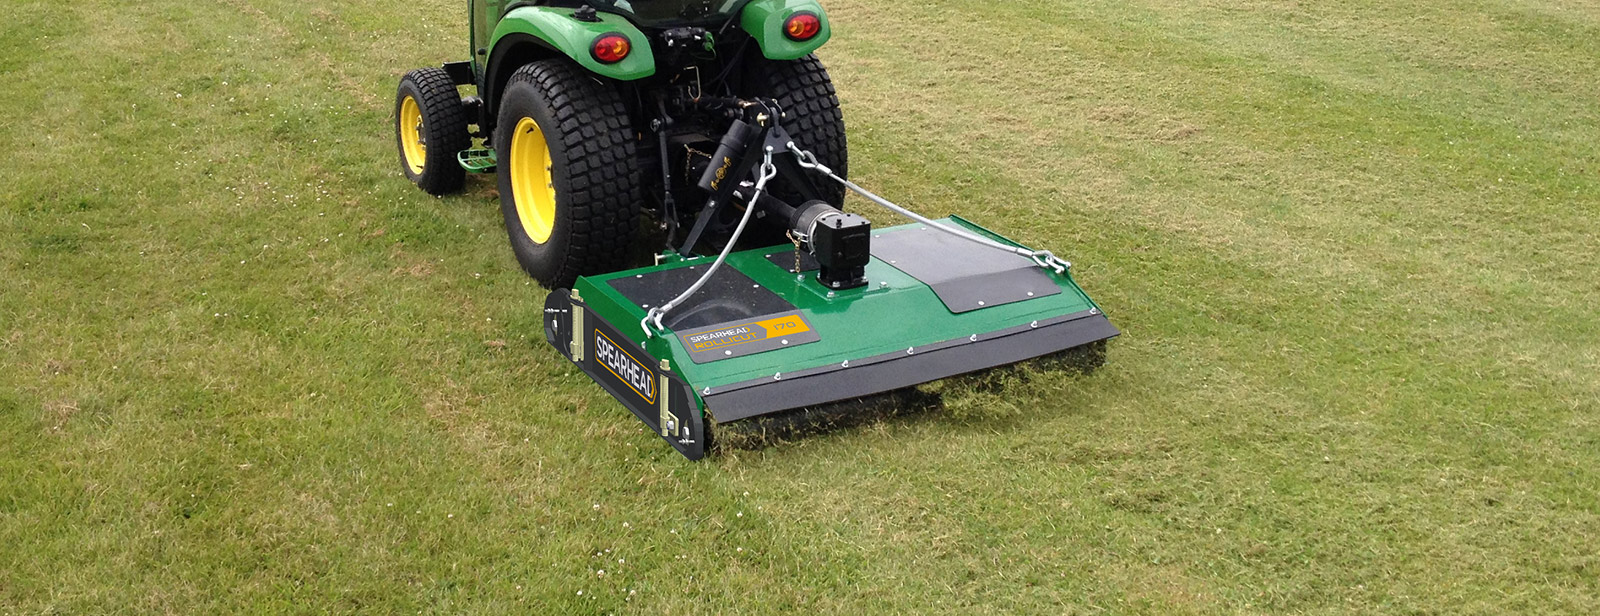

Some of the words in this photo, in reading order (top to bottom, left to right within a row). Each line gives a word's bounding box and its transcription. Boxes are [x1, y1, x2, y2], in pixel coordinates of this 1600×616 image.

[690, 326, 751, 343] SPEARHEAD
[773, 321, 796, 331] 170
[694, 332, 757, 350] ROLLICUT
[596, 335, 654, 398] SPEARHEAD
